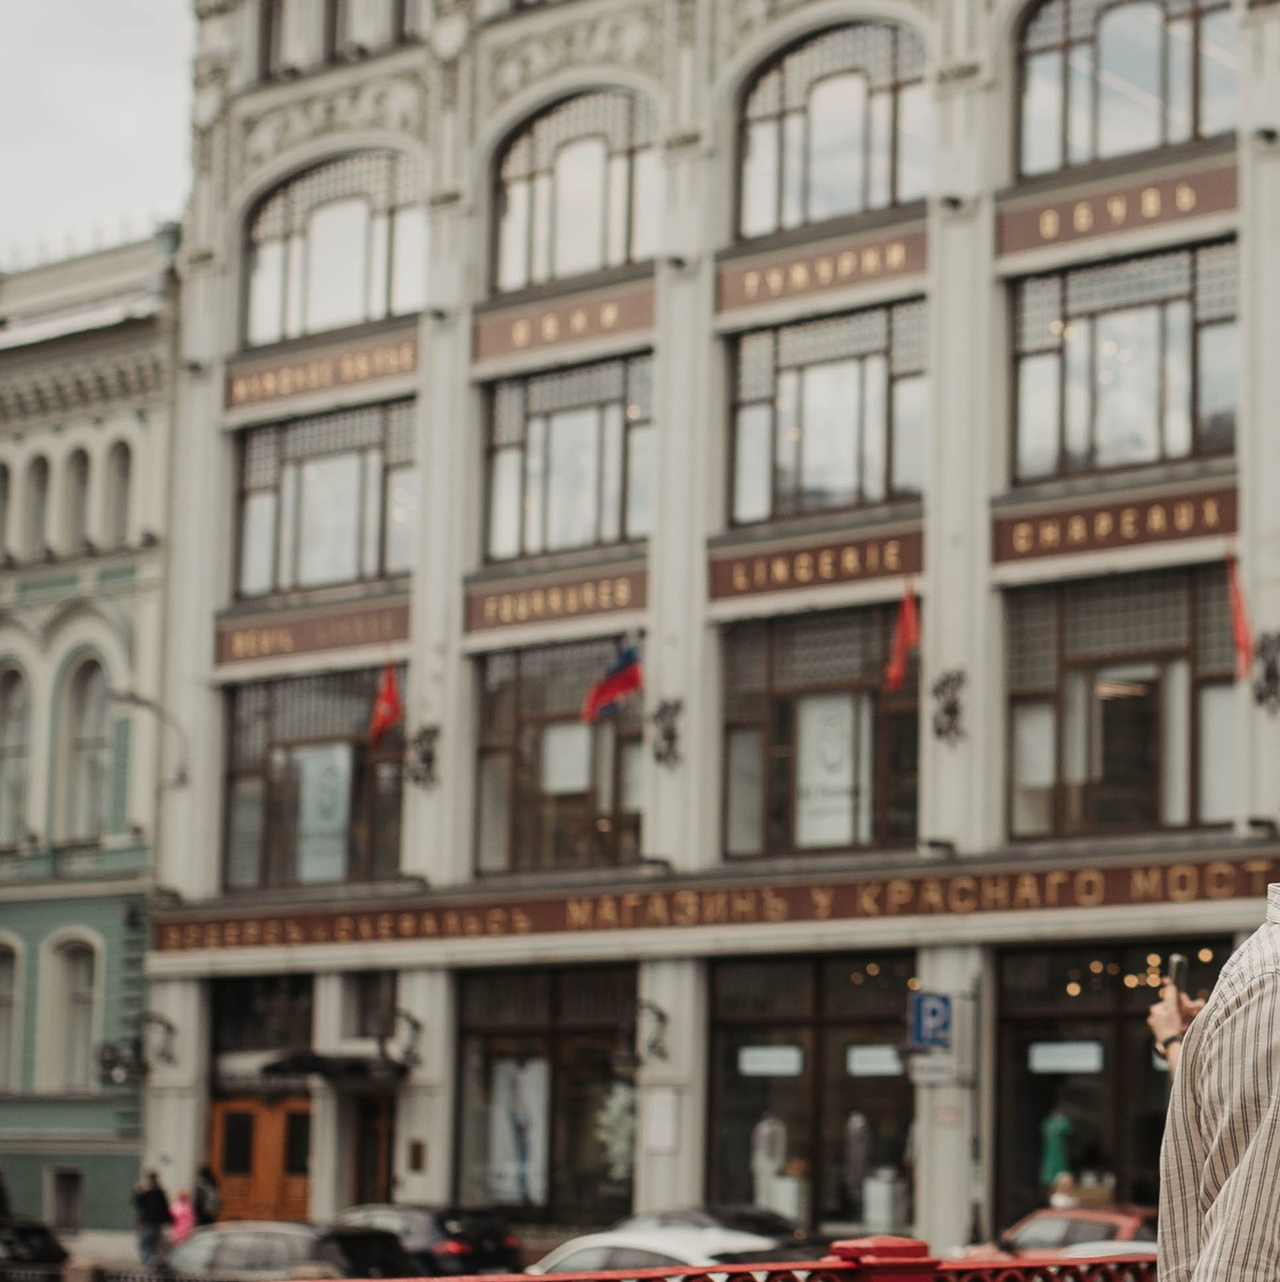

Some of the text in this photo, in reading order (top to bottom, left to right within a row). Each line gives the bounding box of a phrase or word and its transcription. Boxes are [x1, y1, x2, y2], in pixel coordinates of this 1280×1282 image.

[566, 887, 788, 930] МАГАЗИНЪ
[810, 885, 834, 918] У
[857, 869, 1105, 916] КРАСНАГО
